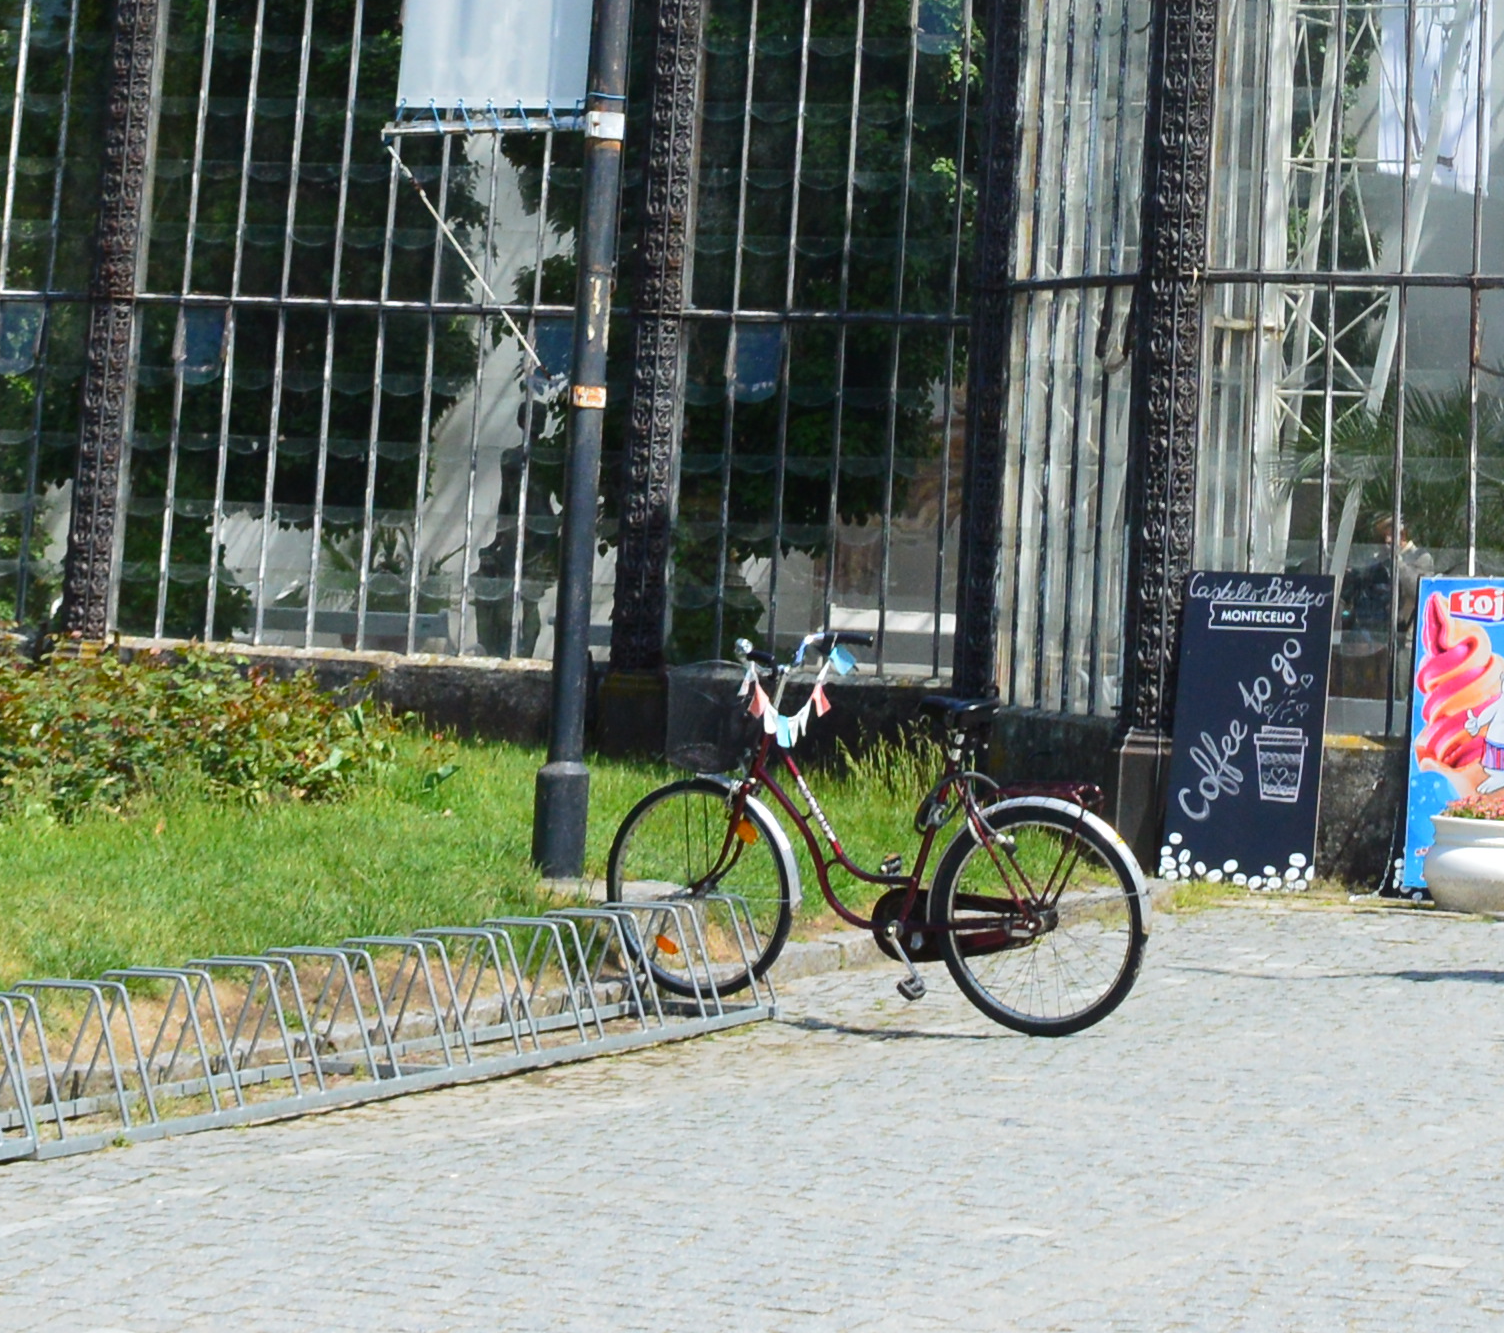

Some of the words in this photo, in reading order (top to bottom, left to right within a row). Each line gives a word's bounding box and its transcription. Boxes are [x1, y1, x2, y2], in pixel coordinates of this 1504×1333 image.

[1189, 572, 1263, 602] Castello
[1261, 577, 1332, 607] Bistro
[1221, 610, 1296, 624] MONTECELIO
[1178, 720, 1248, 821] Coffee
[1238, 676, 1272, 714] to
[1271, 638, 1302, 685] go
